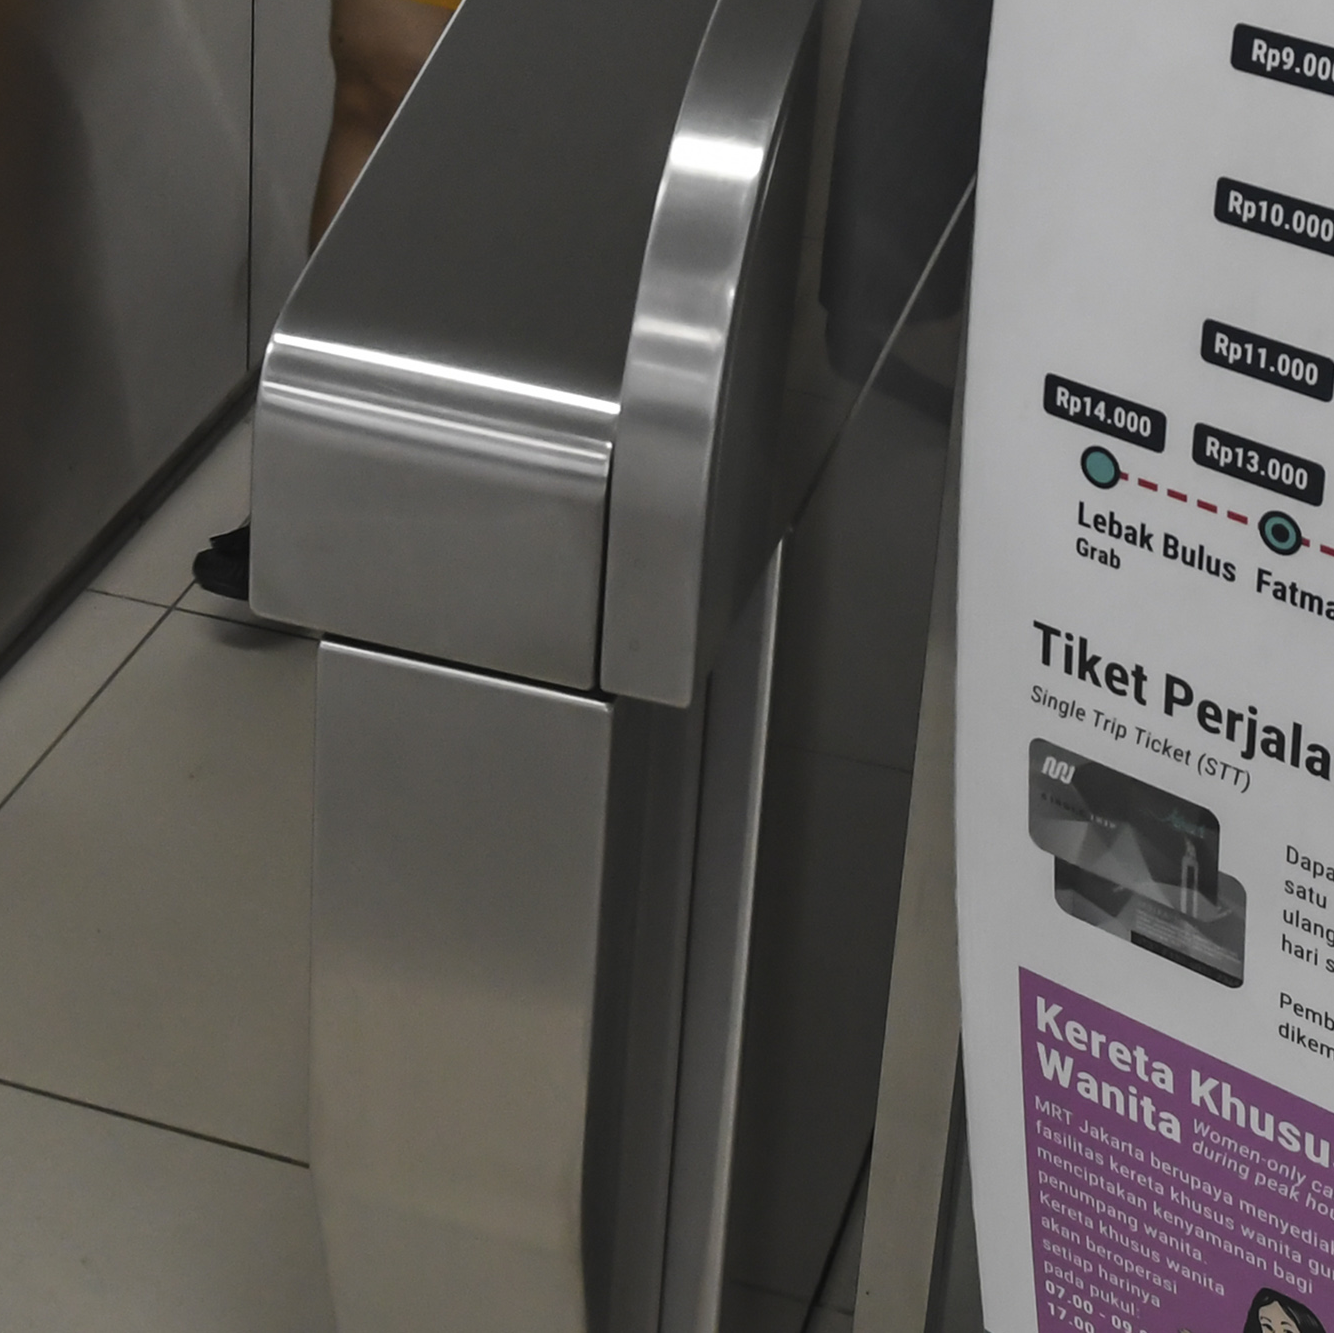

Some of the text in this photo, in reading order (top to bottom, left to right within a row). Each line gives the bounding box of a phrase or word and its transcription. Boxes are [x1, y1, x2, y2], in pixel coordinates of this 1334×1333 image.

[1227, 189, 1334, 242] Rp10.000
[1214, 331, 1319, 386] Rp11.000
[1056, 385, 1152, 438] Rp14.000
[1205, 435, 1308, 490] Rp13.000
[1075, 537, 1121, 570] Grab
[1077, 500, 1237, 583] Lebak Bulus
[1032, 619, 1148, 707] Tiket
[1030, 684, 1251, 794] Single Trip Ticket (STT)
[1281, 933, 1319, 967] hari
[1036, 995, 1175, 1095] Kereta
[1036, 1041, 1182, 1144] Wanita
[1034, 1095, 1073, 1126] MRT
[1078, 1119, 1145, 1163] Jakarta
[1150, 1151, 1234, 1206] berupaya
[1192, 1140, 1250, 1181] during
[1255, 1172, 1300, 1203] peak
[1193, 1119, 1307, 1185] Women-only
